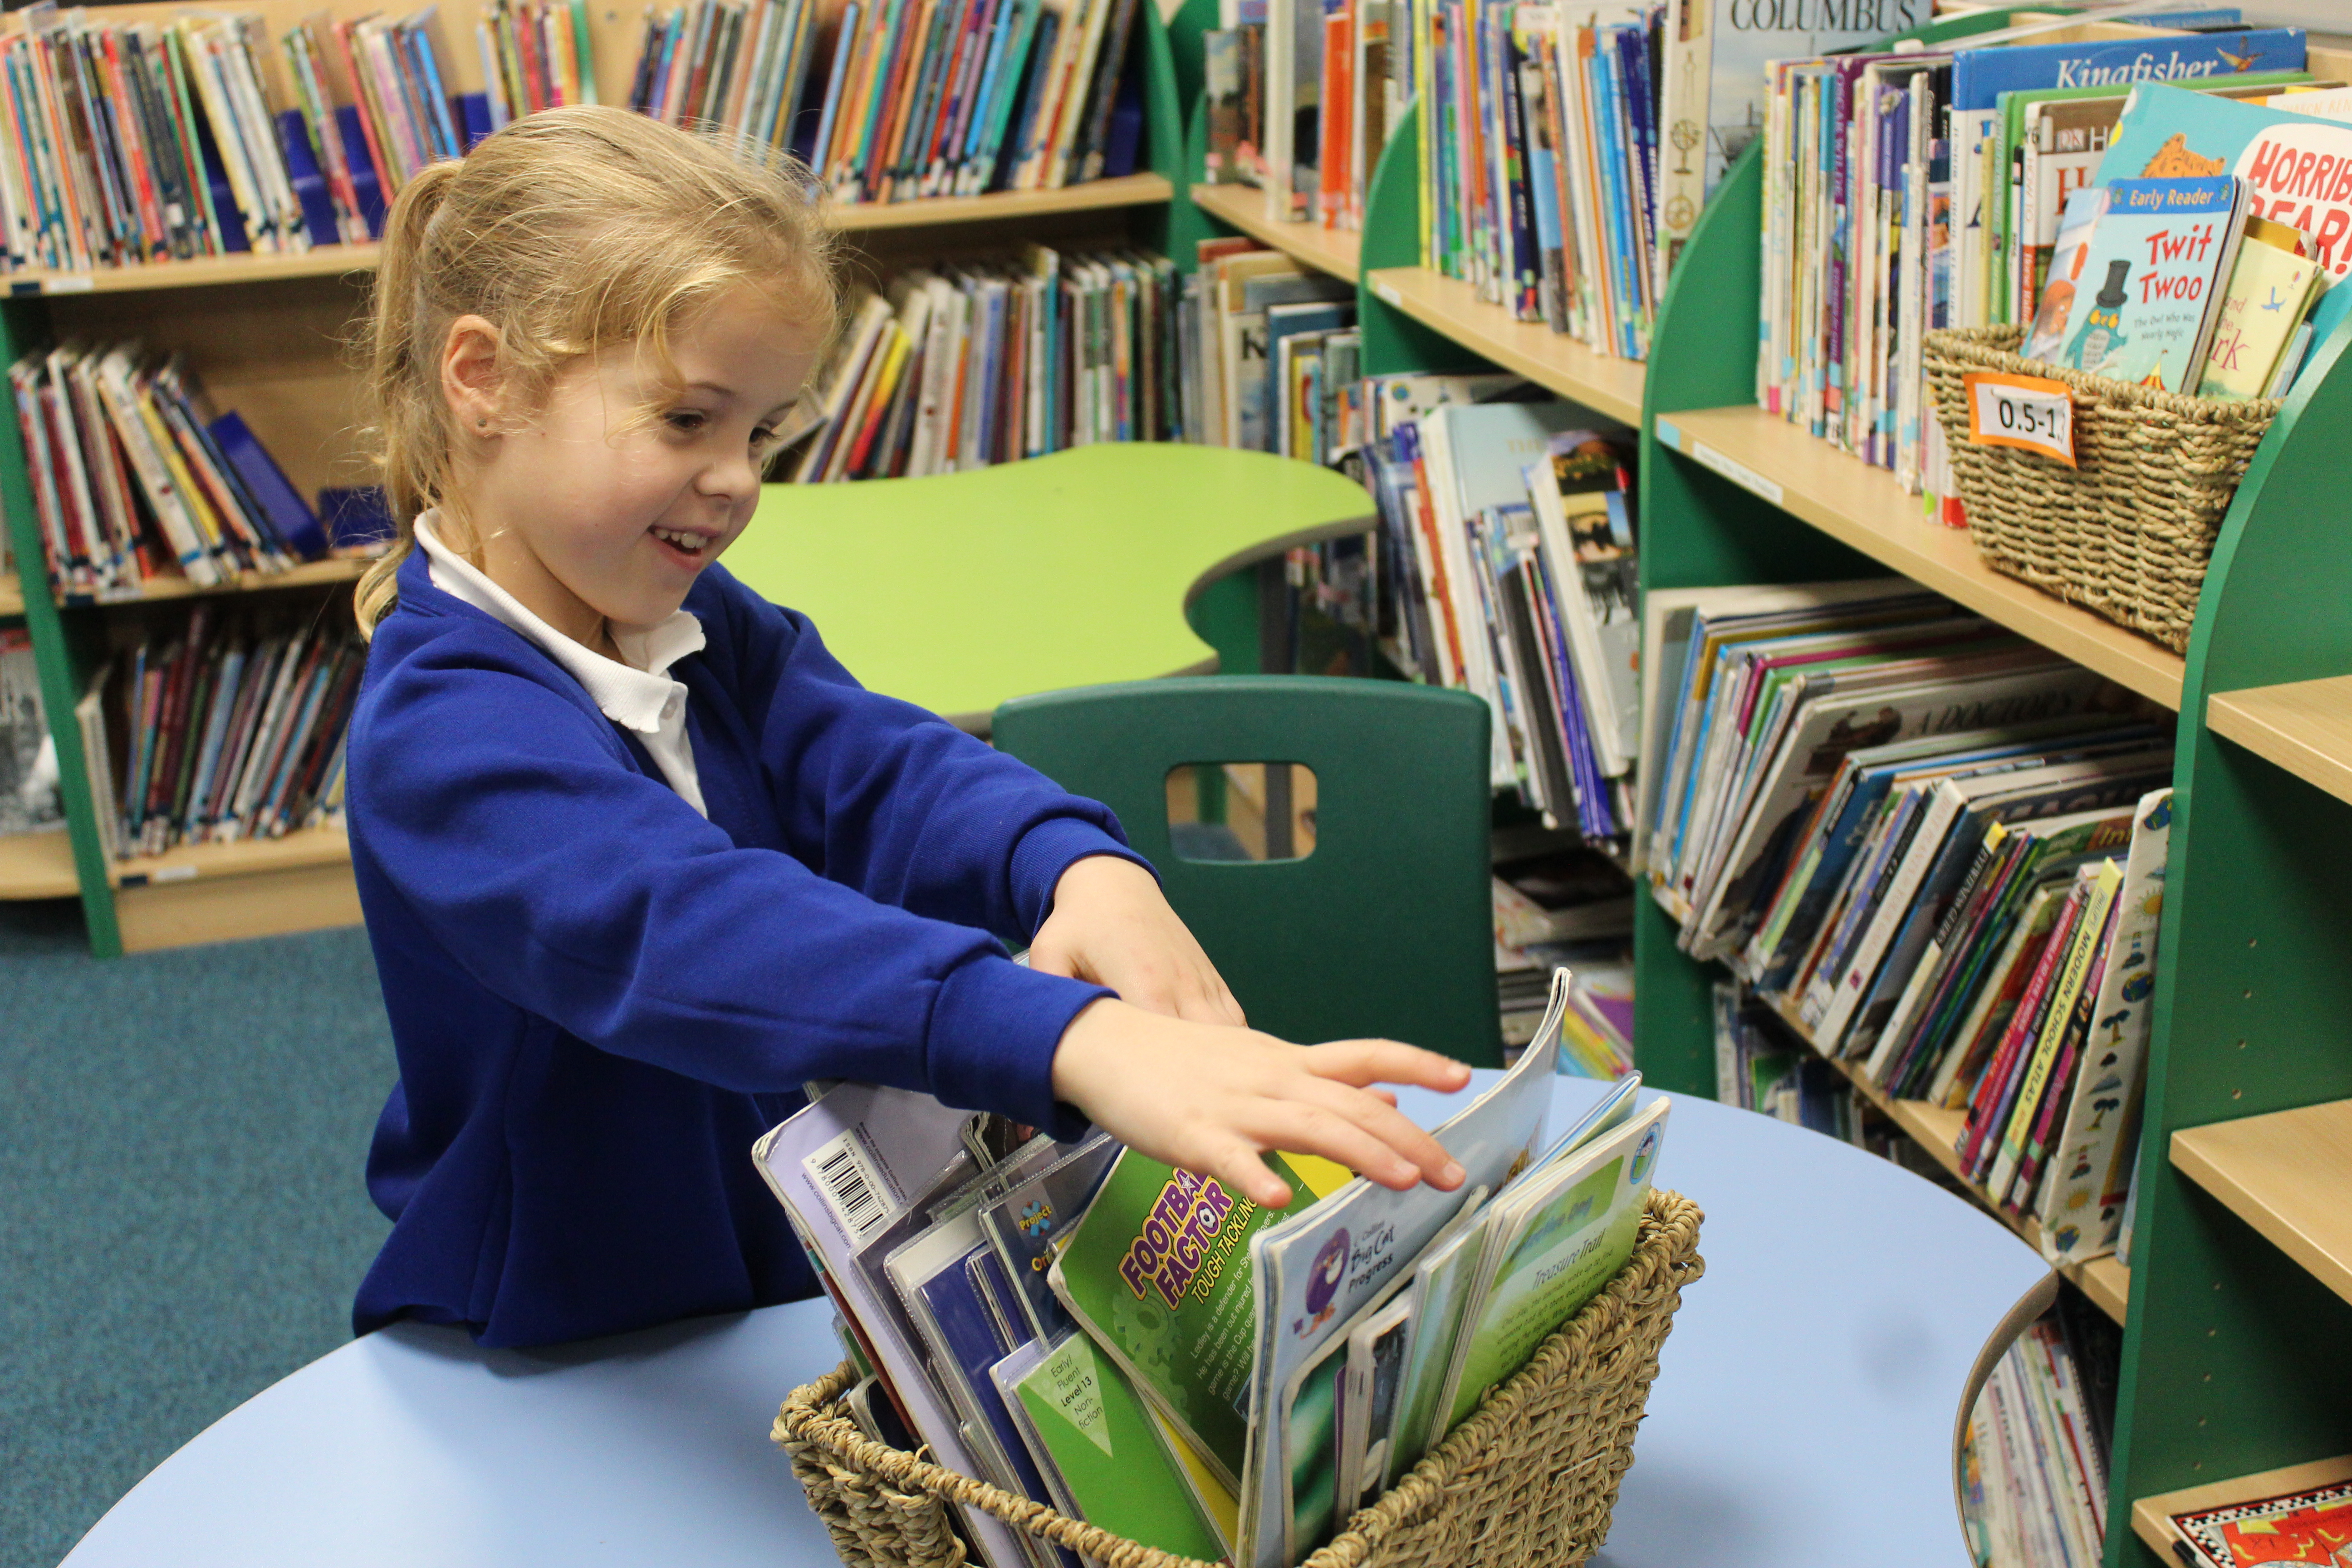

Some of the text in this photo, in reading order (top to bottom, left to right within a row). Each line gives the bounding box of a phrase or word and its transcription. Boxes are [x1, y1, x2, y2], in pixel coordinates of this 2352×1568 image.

[1731, 0, 1916, 33] COLUMBUS
[2057, 52, 2217, 89] Kingfisher
[2059, 129, 2085, 149] DK
[2129, 188, 2214, 211] Early Reader
[2146, 224, 2214, 266] Twit
[2134, 318, 2148, 328] The
[2209, 328, 2251, 371] rk
[2064, 933, 2089, 996] MODERN
[2043, 1001, 2068, 1055] SCHOOL
[2024, 1061, 2046, 1104] ATLAS
[843, 1138, 856, 1156] ISBN
[1019, 1205, 1052, 1230] Project
[1154, 1181, 1234, 1311] FACTOR
[1351, 1225, 1396, 1274] Big Cat
[1533, 1250, 1580, 1290] Treasure
[1580, 1227, 1606, 1258] Trail
[1191, 1250, 1226, 1305] TOUGH
[1348, 1253, 1394, 1293] Progress
[1190, 1331, 1210, 1358] Ledley
[1214, 1280, 1239, 1315] defender
[1232, 1266, 1245, 1281] for
[1196, 1366, 1208, 1379] He
[1204, 1348, 1218, 1365] has
[1213, 1328, 1230, 1348] been
[1225, 1313, 1237, 1328] out
[1233, 1286, 1255, 1314] injured
[1231, 1326, 1248, 1345] Cup
[1051, 1353, 1073, 1379] Early/
[1225, 1344, 1238, 1360] the
[1056, 1366, 1081, 1392] Fluent
[1060, 1376, 1093, 1408] Level 13
[1205, 1368, 1226, 1394] game
[1220, 1370, 1243, 1400] game?
[1237, 1352, 1251, 1369] Will
[1073, 1396, 1094, 1416] Non-
[1078, 1406, 1103, 1430] fiction
